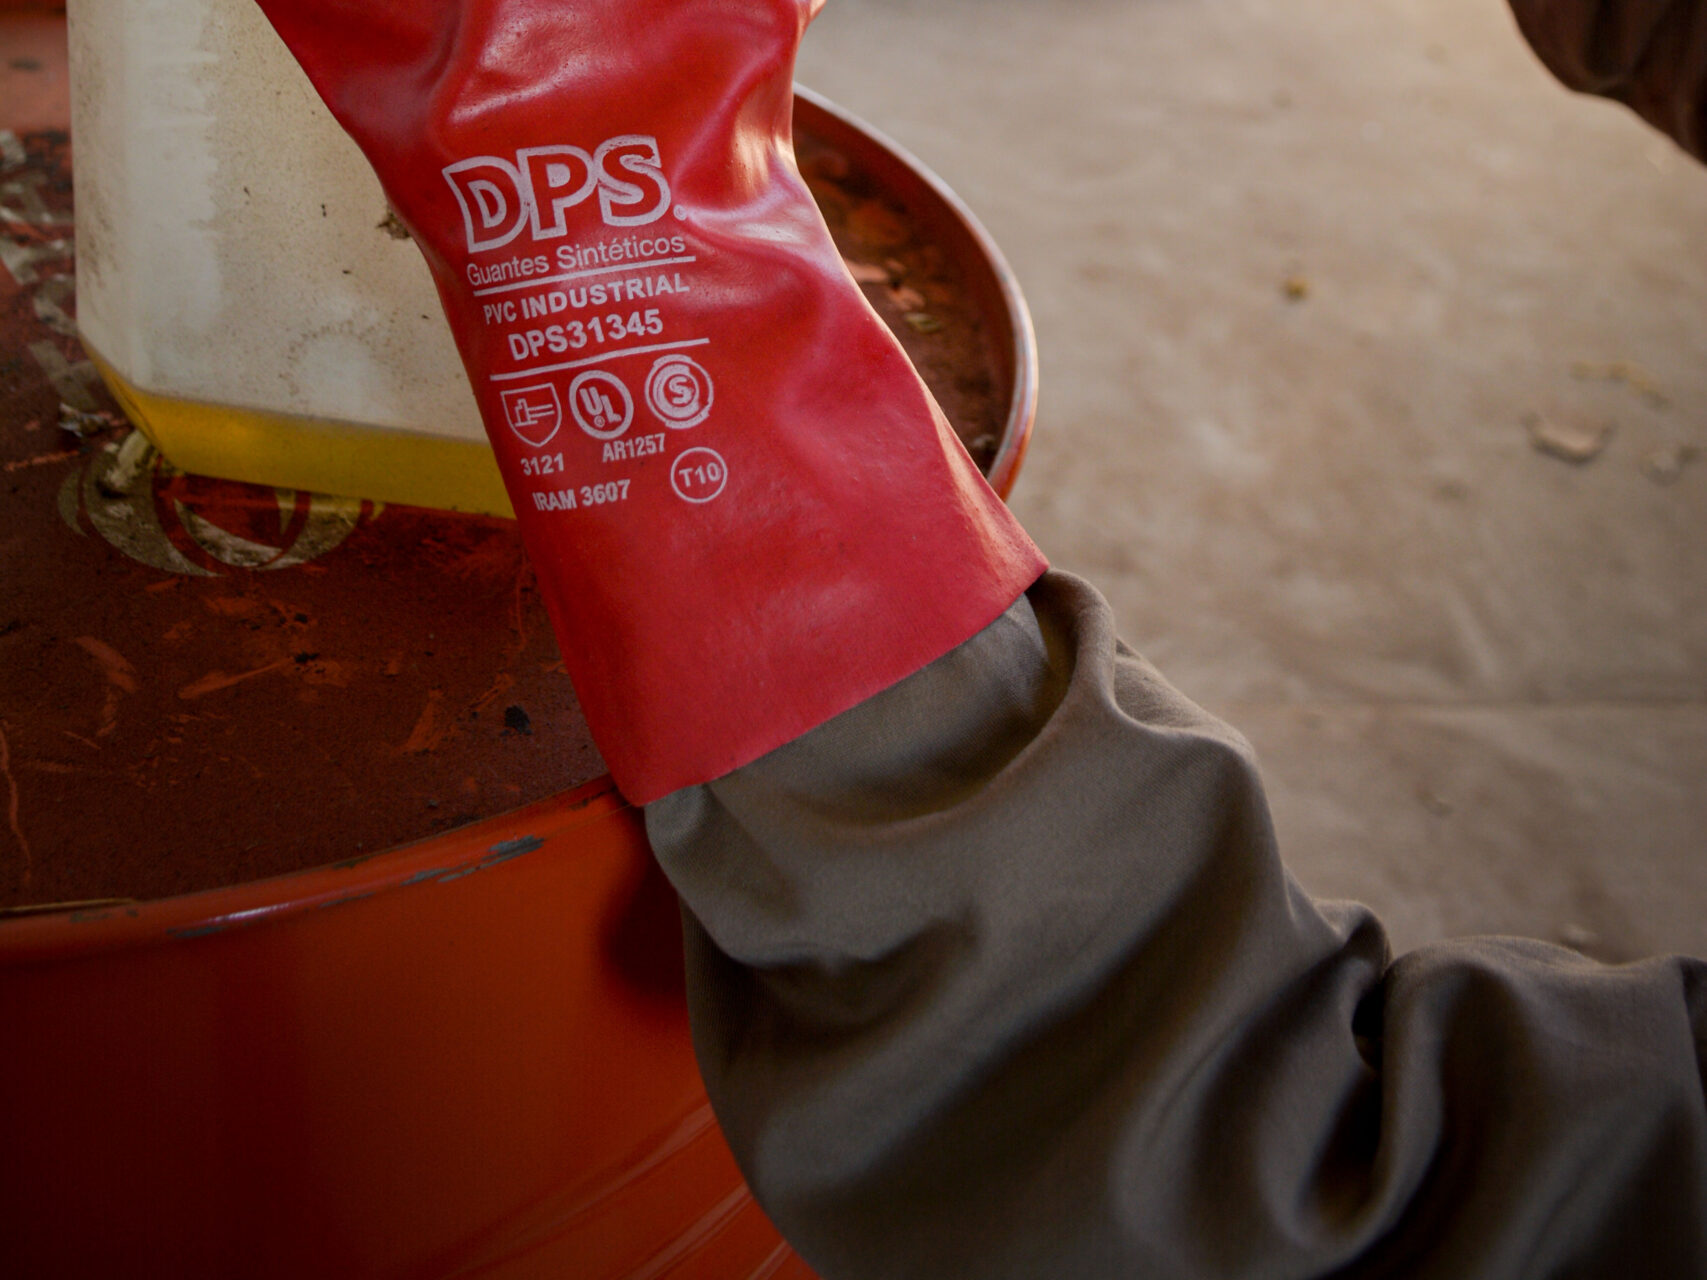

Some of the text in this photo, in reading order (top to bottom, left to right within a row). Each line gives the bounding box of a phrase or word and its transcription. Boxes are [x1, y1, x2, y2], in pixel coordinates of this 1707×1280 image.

[441, 134, 672, 254] DPS
[466, 236, 686, 286] Guantes Sintéticos
[483, 272, 690, 325] PVC INDUSTRIAL
[508, 308, 664, 361] DPS31345
[520, 453, 565, 476] 3121
[602, 432, 666, 463] AR1257
[532, 479, 631, 511] IRAM 3607
[678, 462, 722, 488] T10
